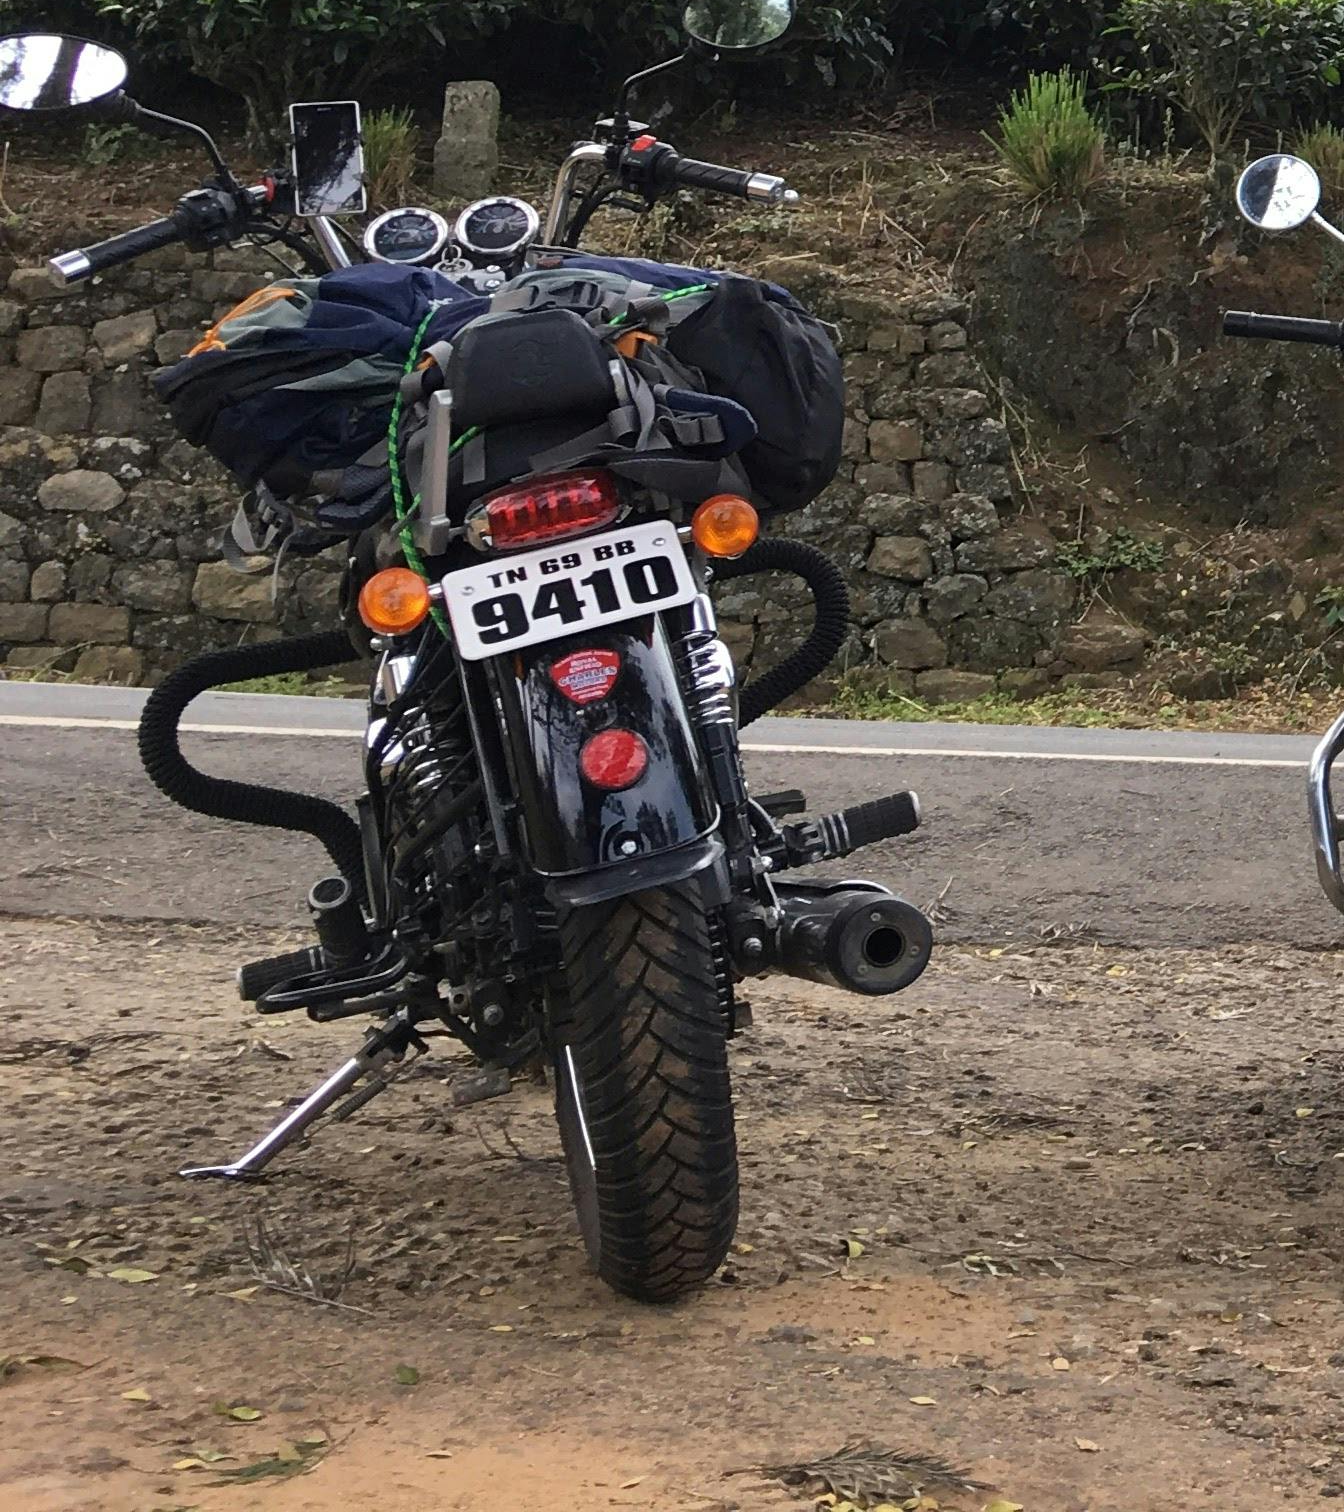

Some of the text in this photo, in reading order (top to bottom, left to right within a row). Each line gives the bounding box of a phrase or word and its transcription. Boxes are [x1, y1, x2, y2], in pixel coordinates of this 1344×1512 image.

[487, 540, 637, 589] TN 69 BB
[471, 555, 680, 646] 9410
